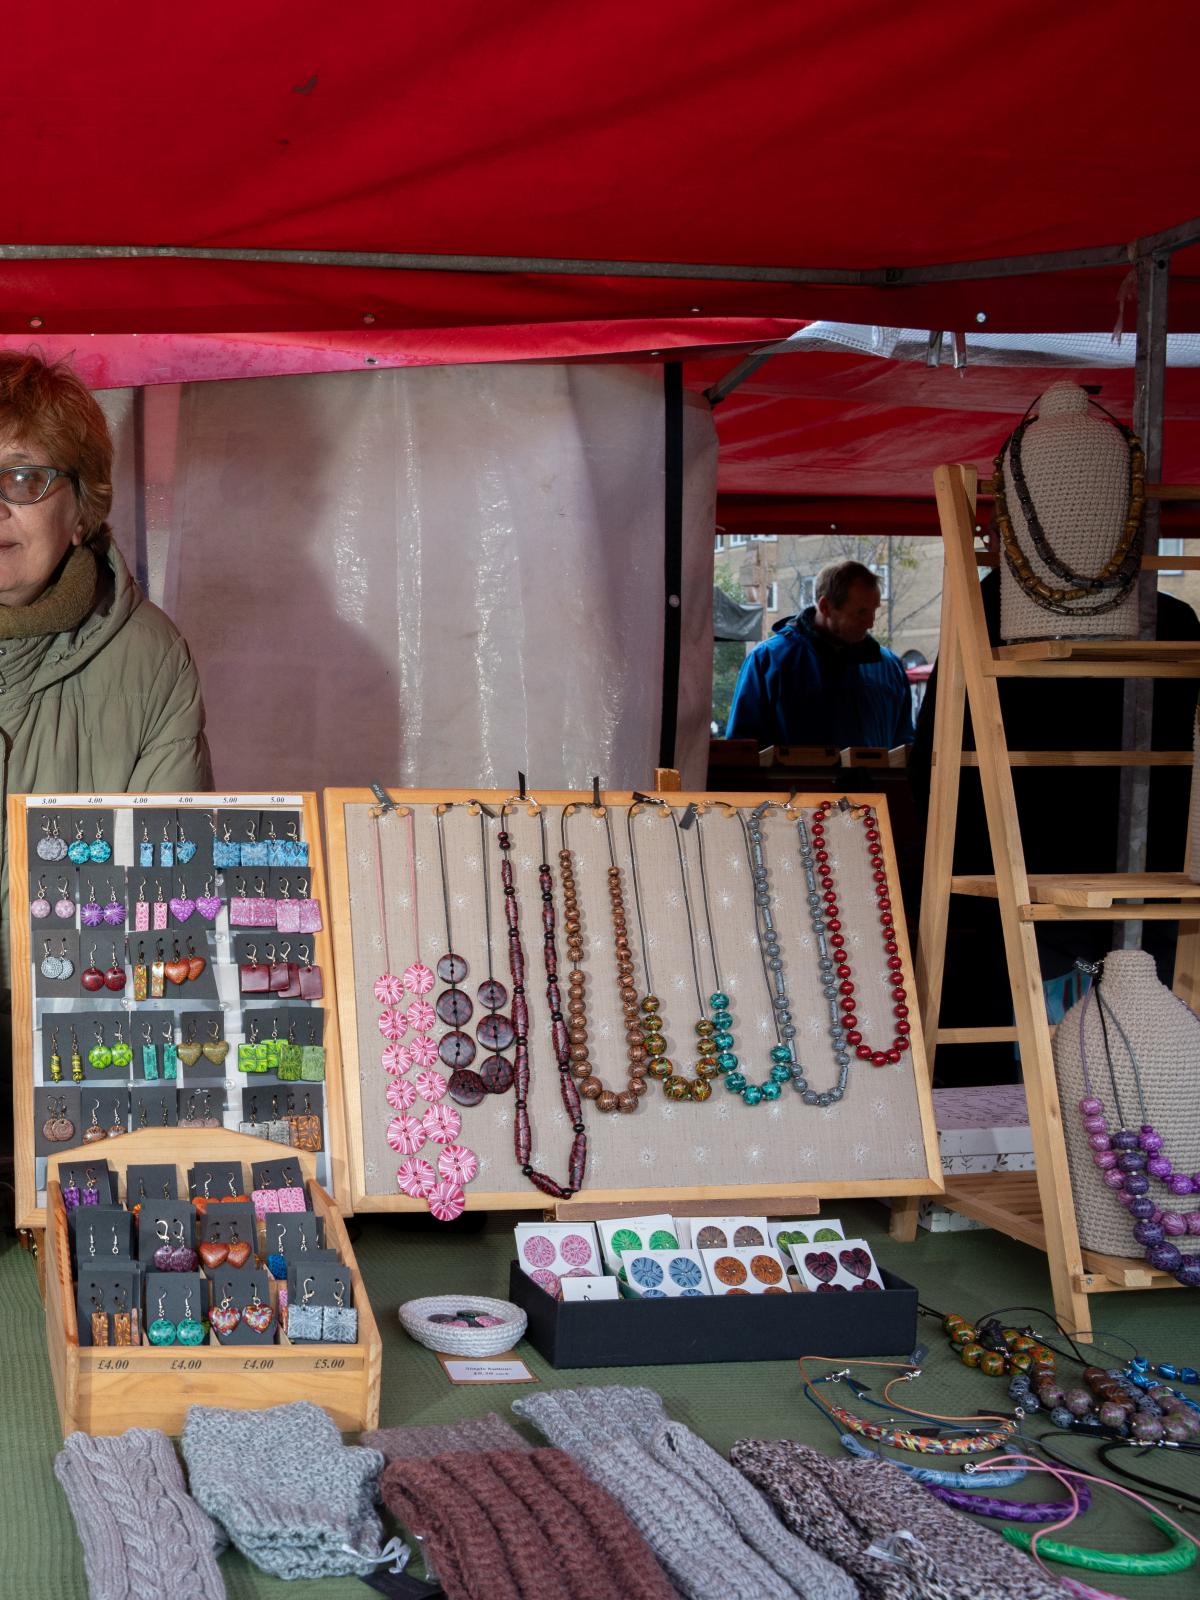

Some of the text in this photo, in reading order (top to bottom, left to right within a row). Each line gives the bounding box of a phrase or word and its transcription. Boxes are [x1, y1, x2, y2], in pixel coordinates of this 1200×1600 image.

[222, 796, 238, 804] 5.00
[97, 1358, 345, 1370] £4.00 £4.00 £4.00 £5.00
